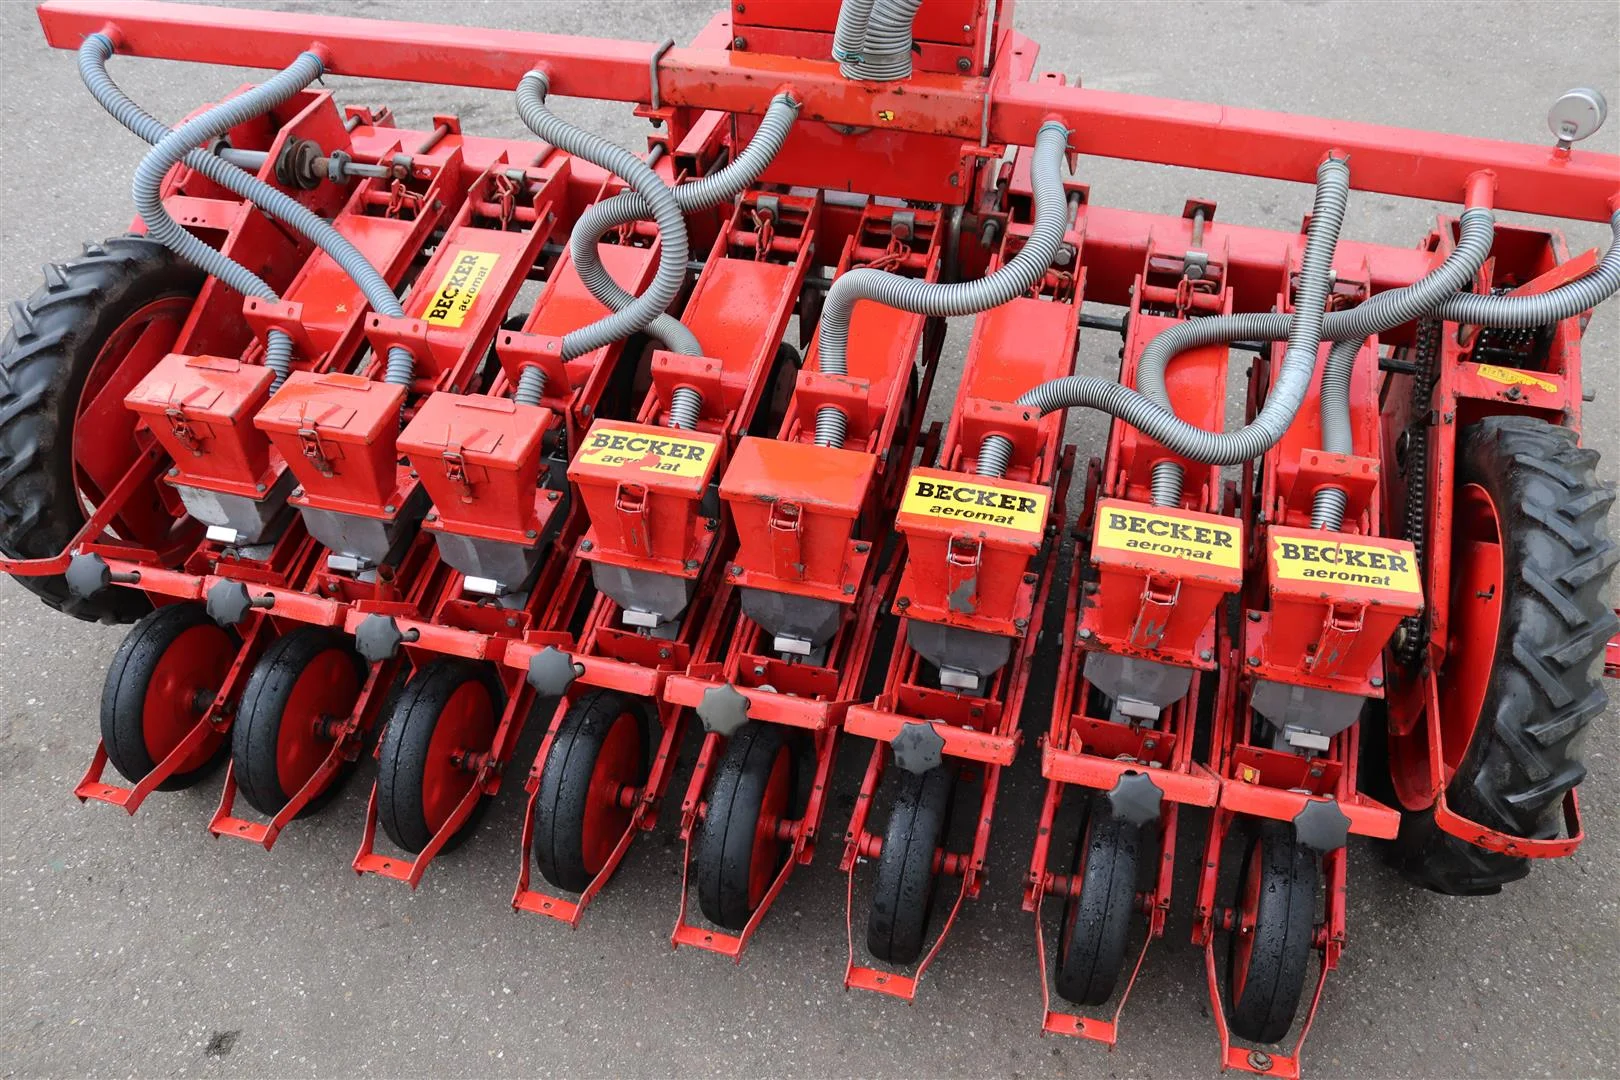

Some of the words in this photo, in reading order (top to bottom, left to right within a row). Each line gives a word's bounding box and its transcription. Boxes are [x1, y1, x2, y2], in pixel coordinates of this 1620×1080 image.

[429, 255, 479, 319] BECKER
[458, 266, 489, 311] aeromat
[591, 433, 705, 461] BECKER
[915, 482, 1037, 514] BECKER
[929, 505, 1015, 525] aeromat
[1109, 513, 1232, 548] BECKER
[1126, 539, 1213, 560] aeromat
[1281, 542, 1408, 573] BECKER
[1303, 568, 1391, 586] aeromat
